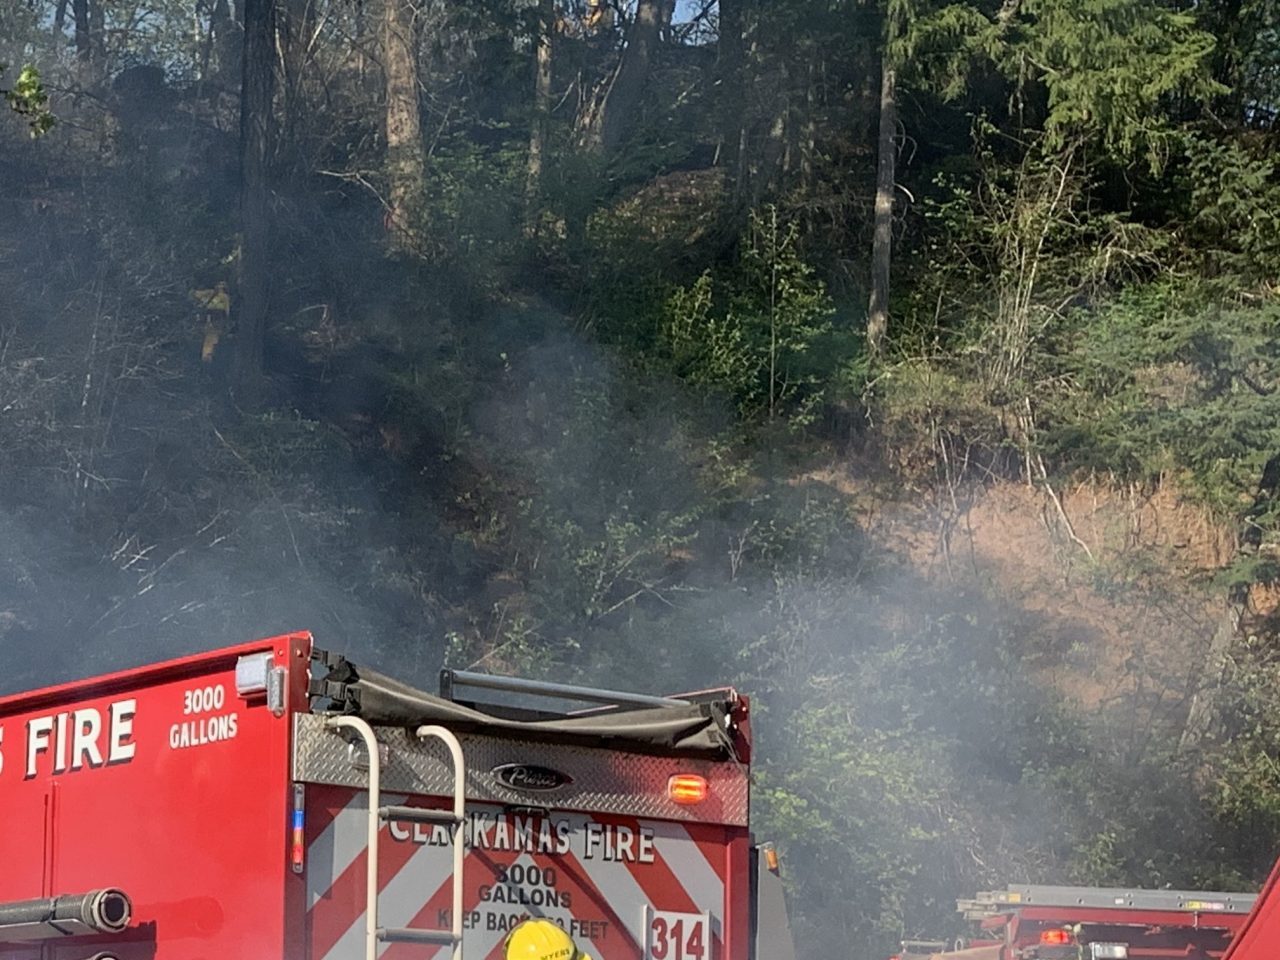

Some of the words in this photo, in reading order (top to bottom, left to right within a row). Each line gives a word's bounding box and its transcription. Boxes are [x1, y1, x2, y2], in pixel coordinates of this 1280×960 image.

[183, 684, 224, 715] 3000
[24, 699, 137, 780] FIRE
[169, 712, 238, 749] GALLONS
[584, 822, 656, 864] FIRE
[495, 863, 558, 888] 3000
[479, 886, 572, 909] GALLONS
[438, 907, 481, 929] KEP
[571, 919, 610, 939] FEET
